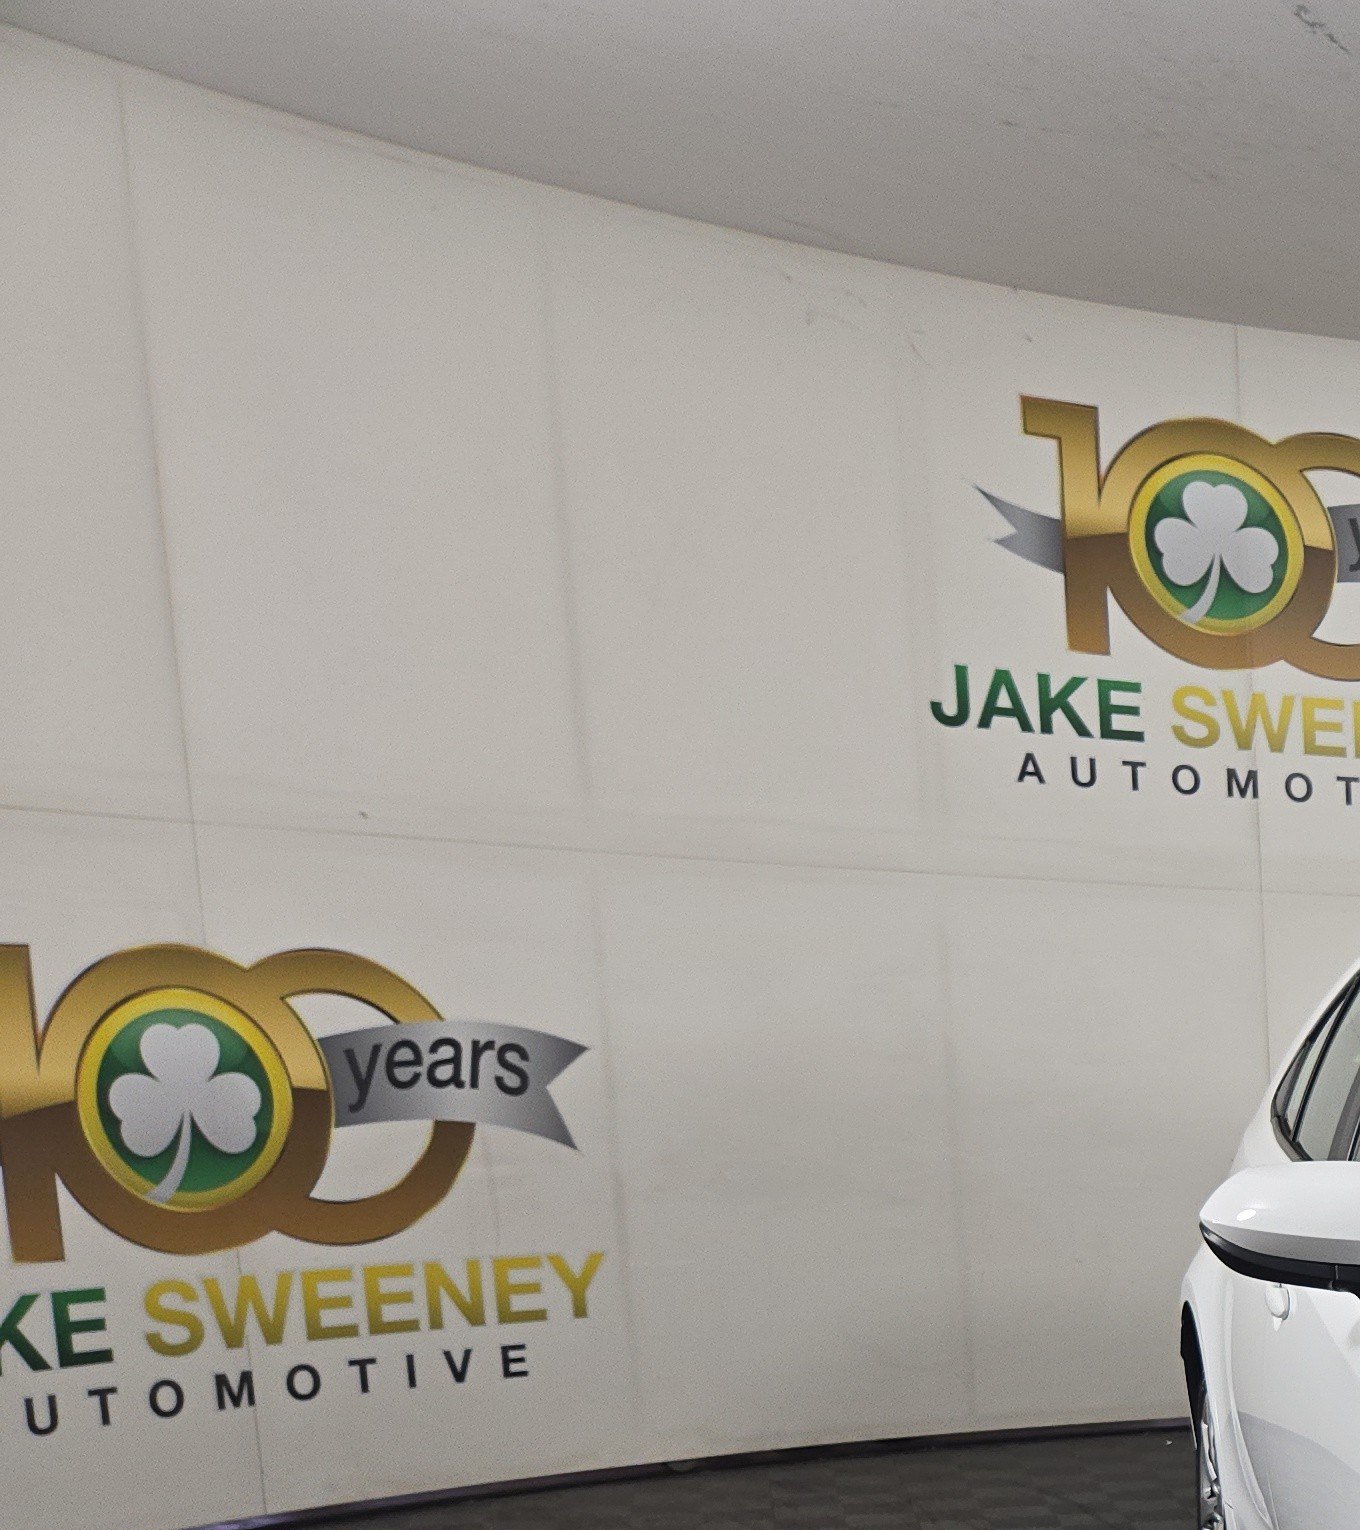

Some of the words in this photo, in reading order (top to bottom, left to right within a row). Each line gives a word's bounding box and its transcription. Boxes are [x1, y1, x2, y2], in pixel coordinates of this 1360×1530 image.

[930, 664, 1145, 742] JAKE
[344, 1036, 530, 1114] years
[143, 1252, 605, 1358] SWEENEY
[24, 1343, 530, 1437] UTOMOTIVE
